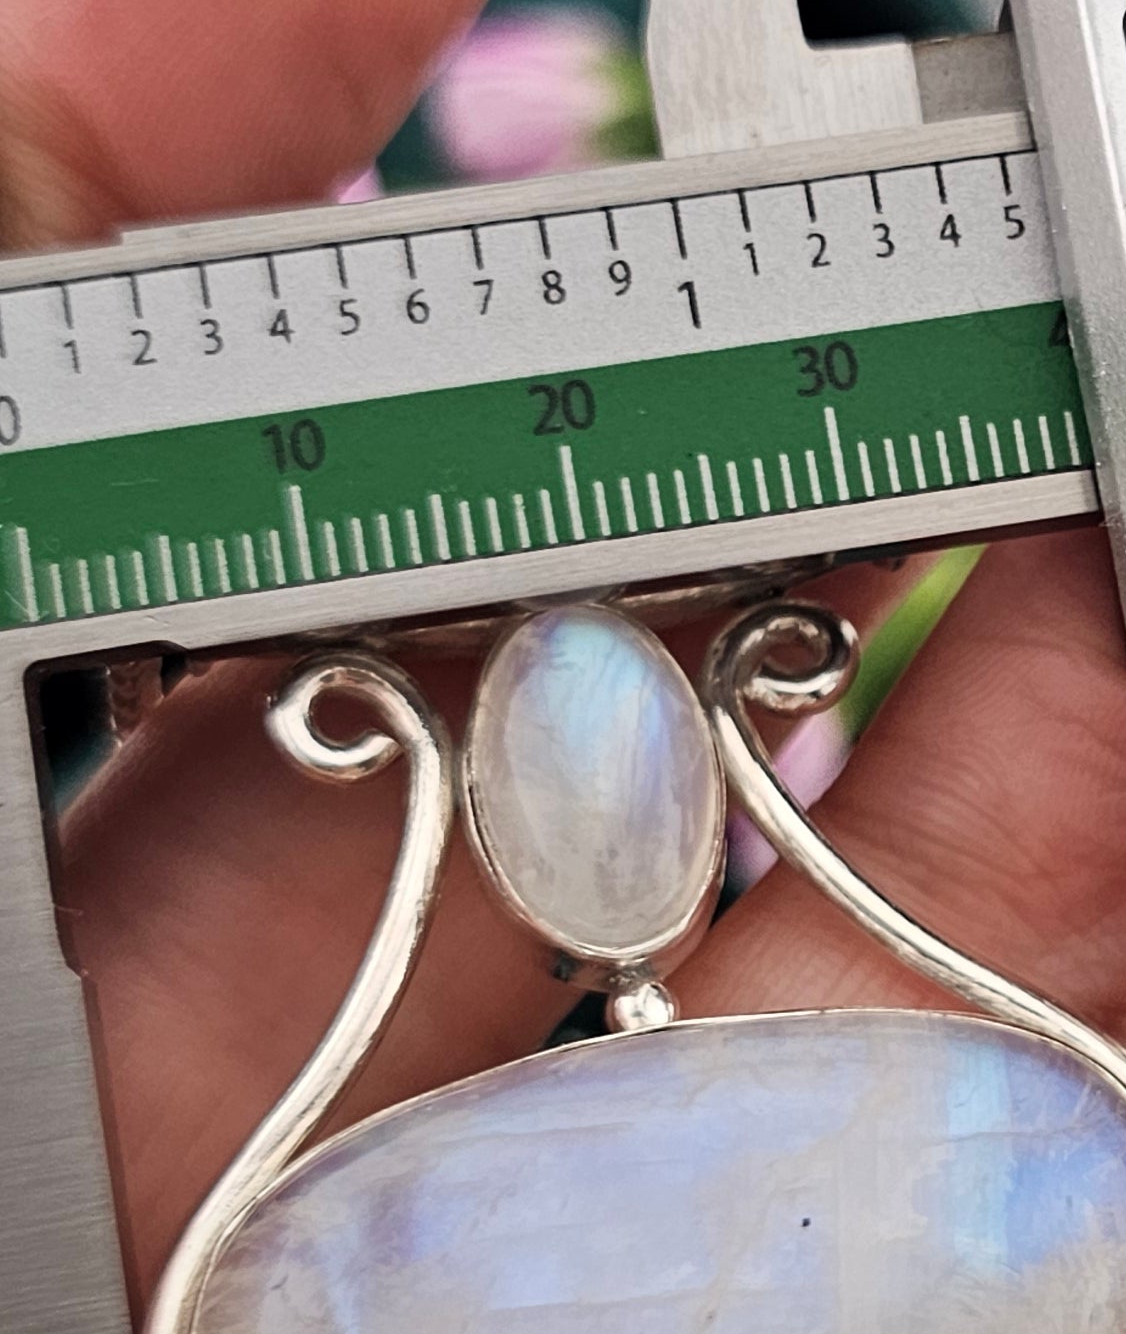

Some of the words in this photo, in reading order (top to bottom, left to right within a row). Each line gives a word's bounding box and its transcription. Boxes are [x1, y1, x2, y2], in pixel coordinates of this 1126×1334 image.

[64, 340, 81, 373] 1
[132, 329, 156, 366] 2
[201, 319, 223, 354] 3
[269, 309, 295, 343] 4
[339, 299, 361, 335] 5
[406, 288, 430, 324] 6
[473, 279, 495, 315] 7
[541, 270, 566, 305] 8
[608, 260, 632, 296] 9
[677, 280, 701, 328] 1
[744, 242, 759, 275] 1
[807, 233, 831, 268] 2
[873, 223, 896, 257] 3
[939, 213, 962, 248] 4
[1004, 204, 1026, 240] 5
[261, 418, 326, 473] 10
[528, 379, 597, 436] 20
[791, 340, 859, 398] 30
